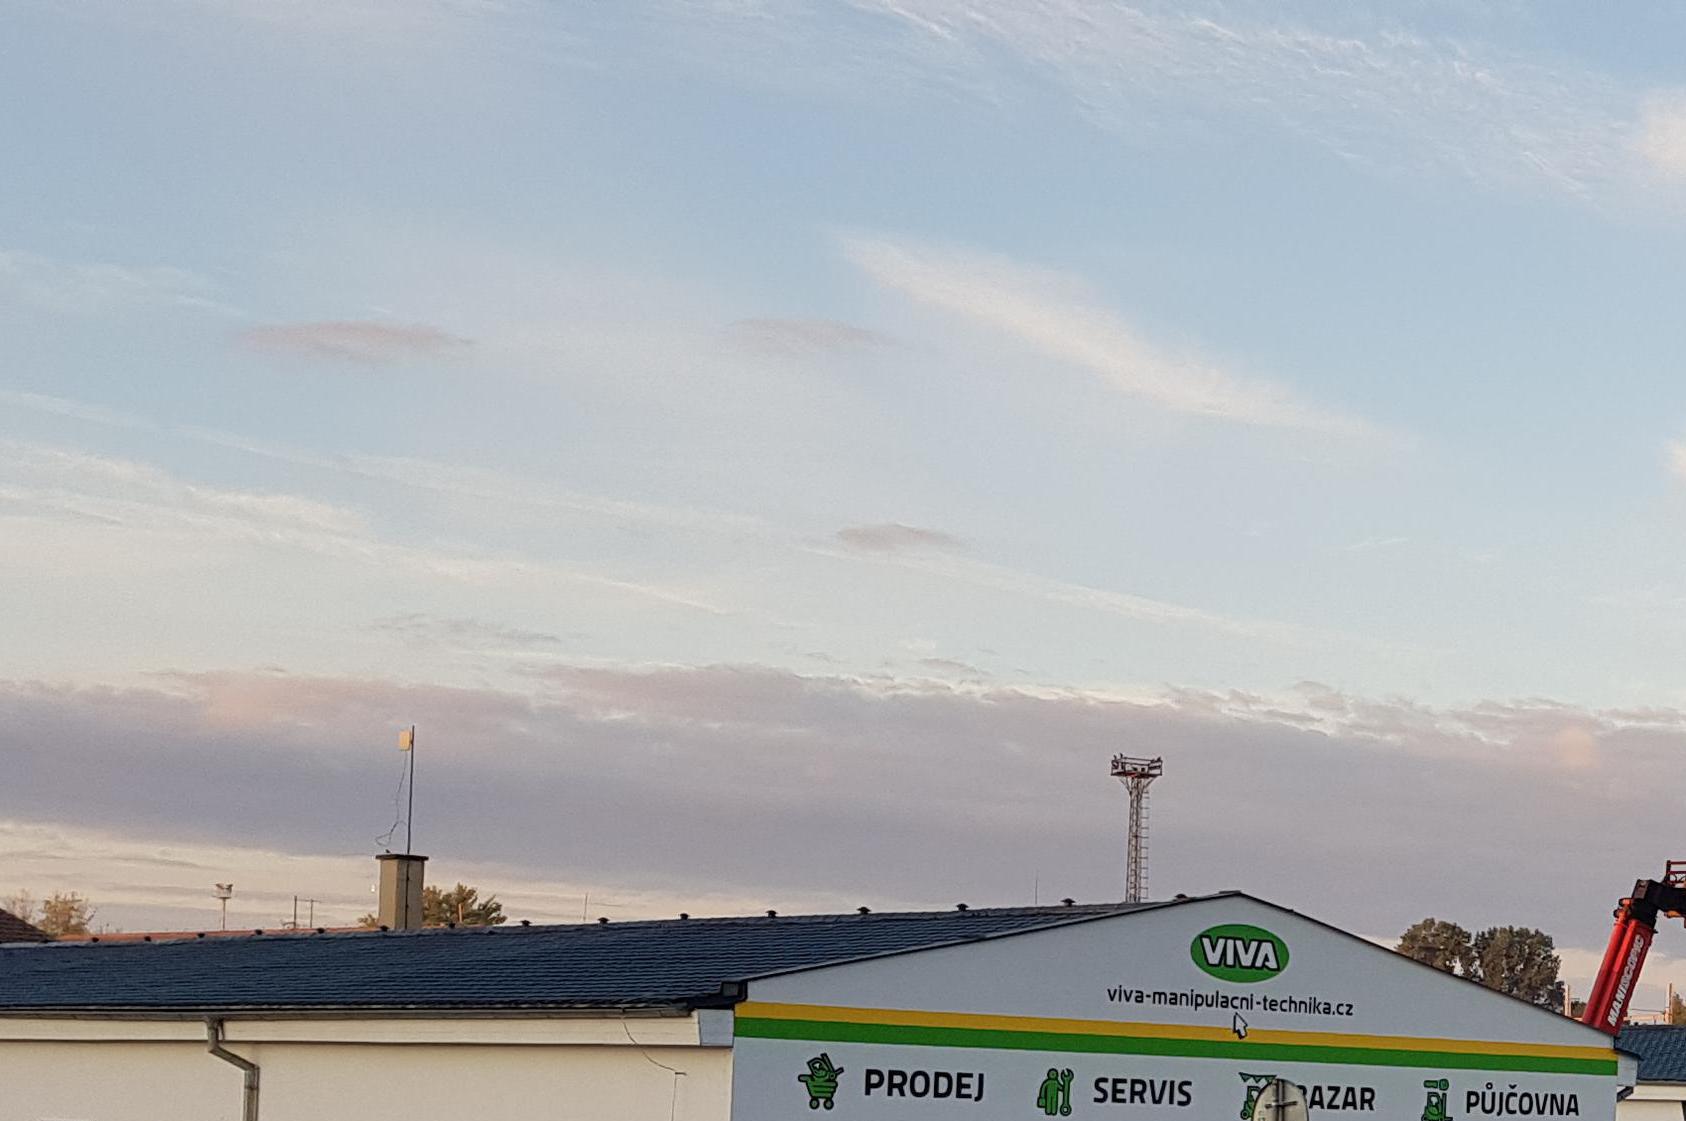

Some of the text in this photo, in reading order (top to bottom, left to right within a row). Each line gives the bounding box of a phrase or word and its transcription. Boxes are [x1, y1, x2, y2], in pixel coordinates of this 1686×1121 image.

[1200, 935, 1280, 971] VIVA
[1107, 985, 1354, 1016] viva-manipulacni-technika.cz
[864, 1068, 985, 1103] PRODEJ
[1093, 1077, 1194, 1107] SERVIS
[1465, 1082, 1581, 1117] PŮJČOVNA
